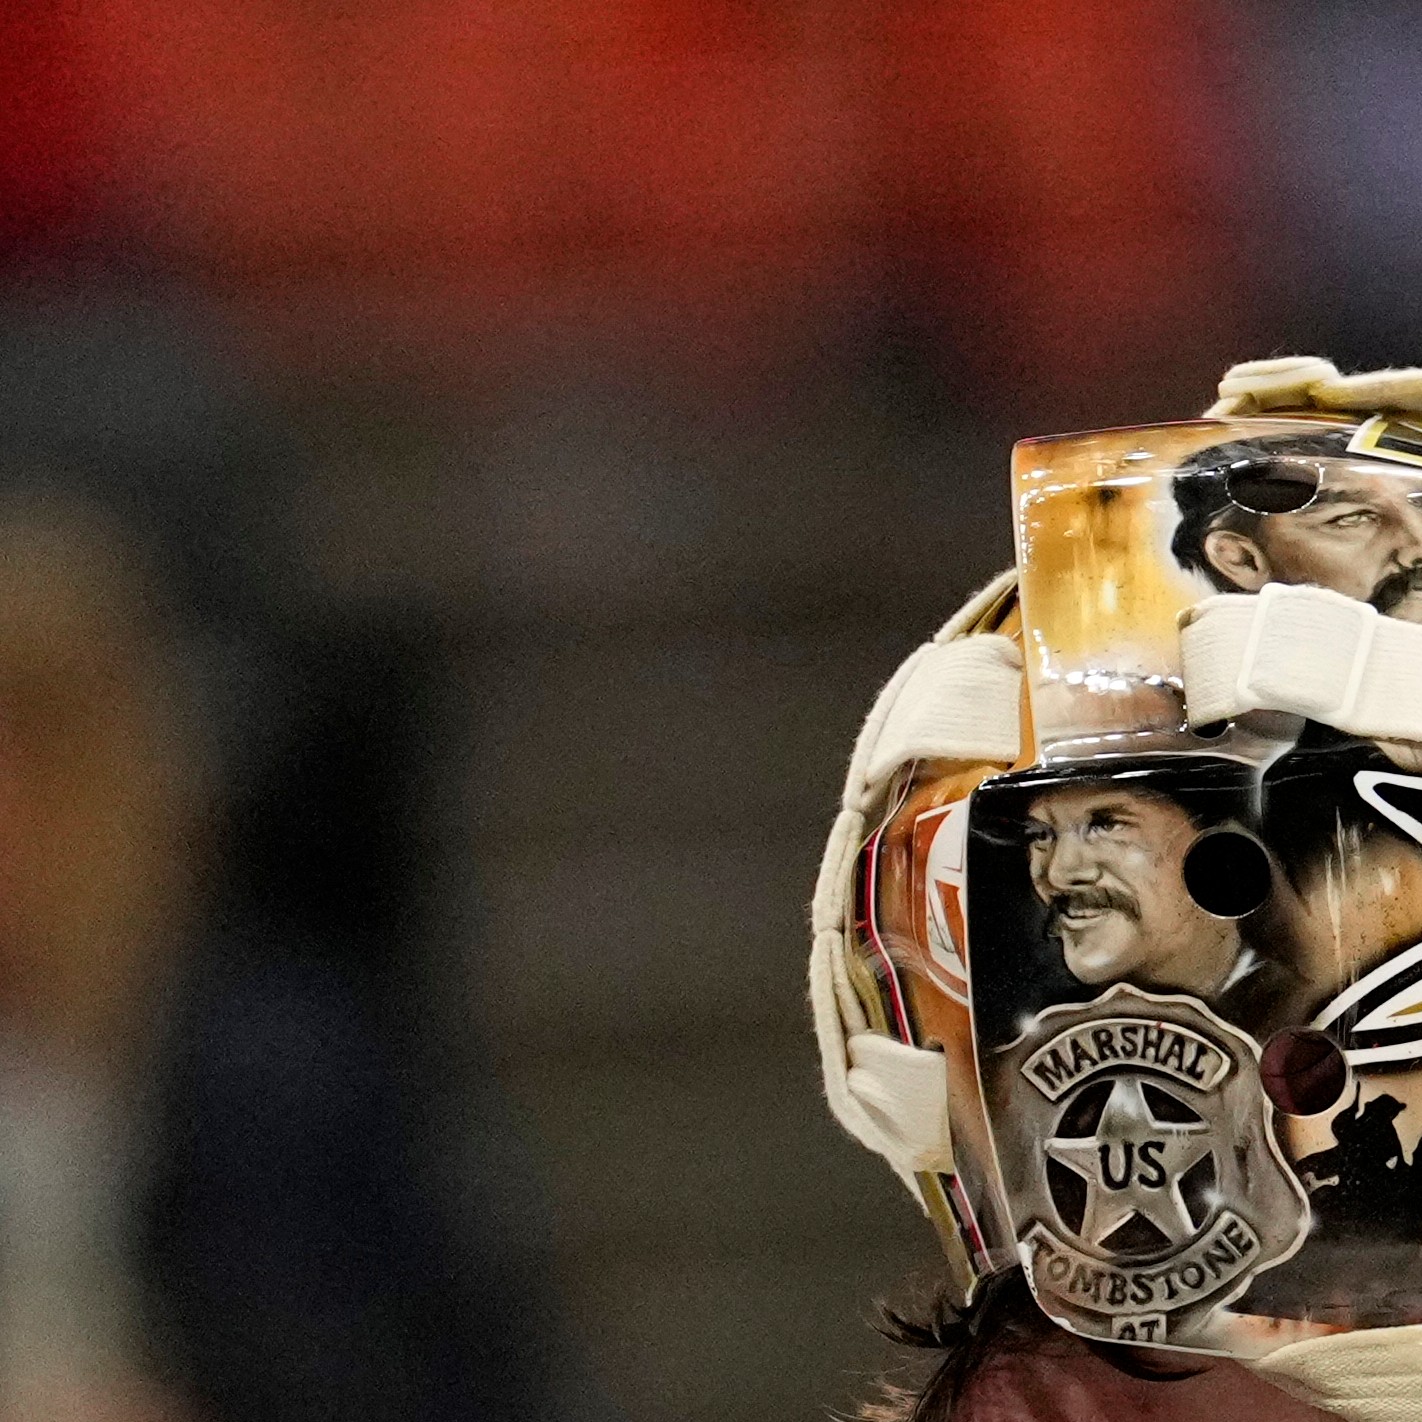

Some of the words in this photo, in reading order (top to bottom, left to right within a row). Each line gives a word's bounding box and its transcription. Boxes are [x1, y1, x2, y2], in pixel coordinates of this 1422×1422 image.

[1032, 1025, 1208, 1092] MARSHAL
[1098, 1140, 1167, 1191] US
[1032, 1219, 1254, 1306] TOMBSTONE
